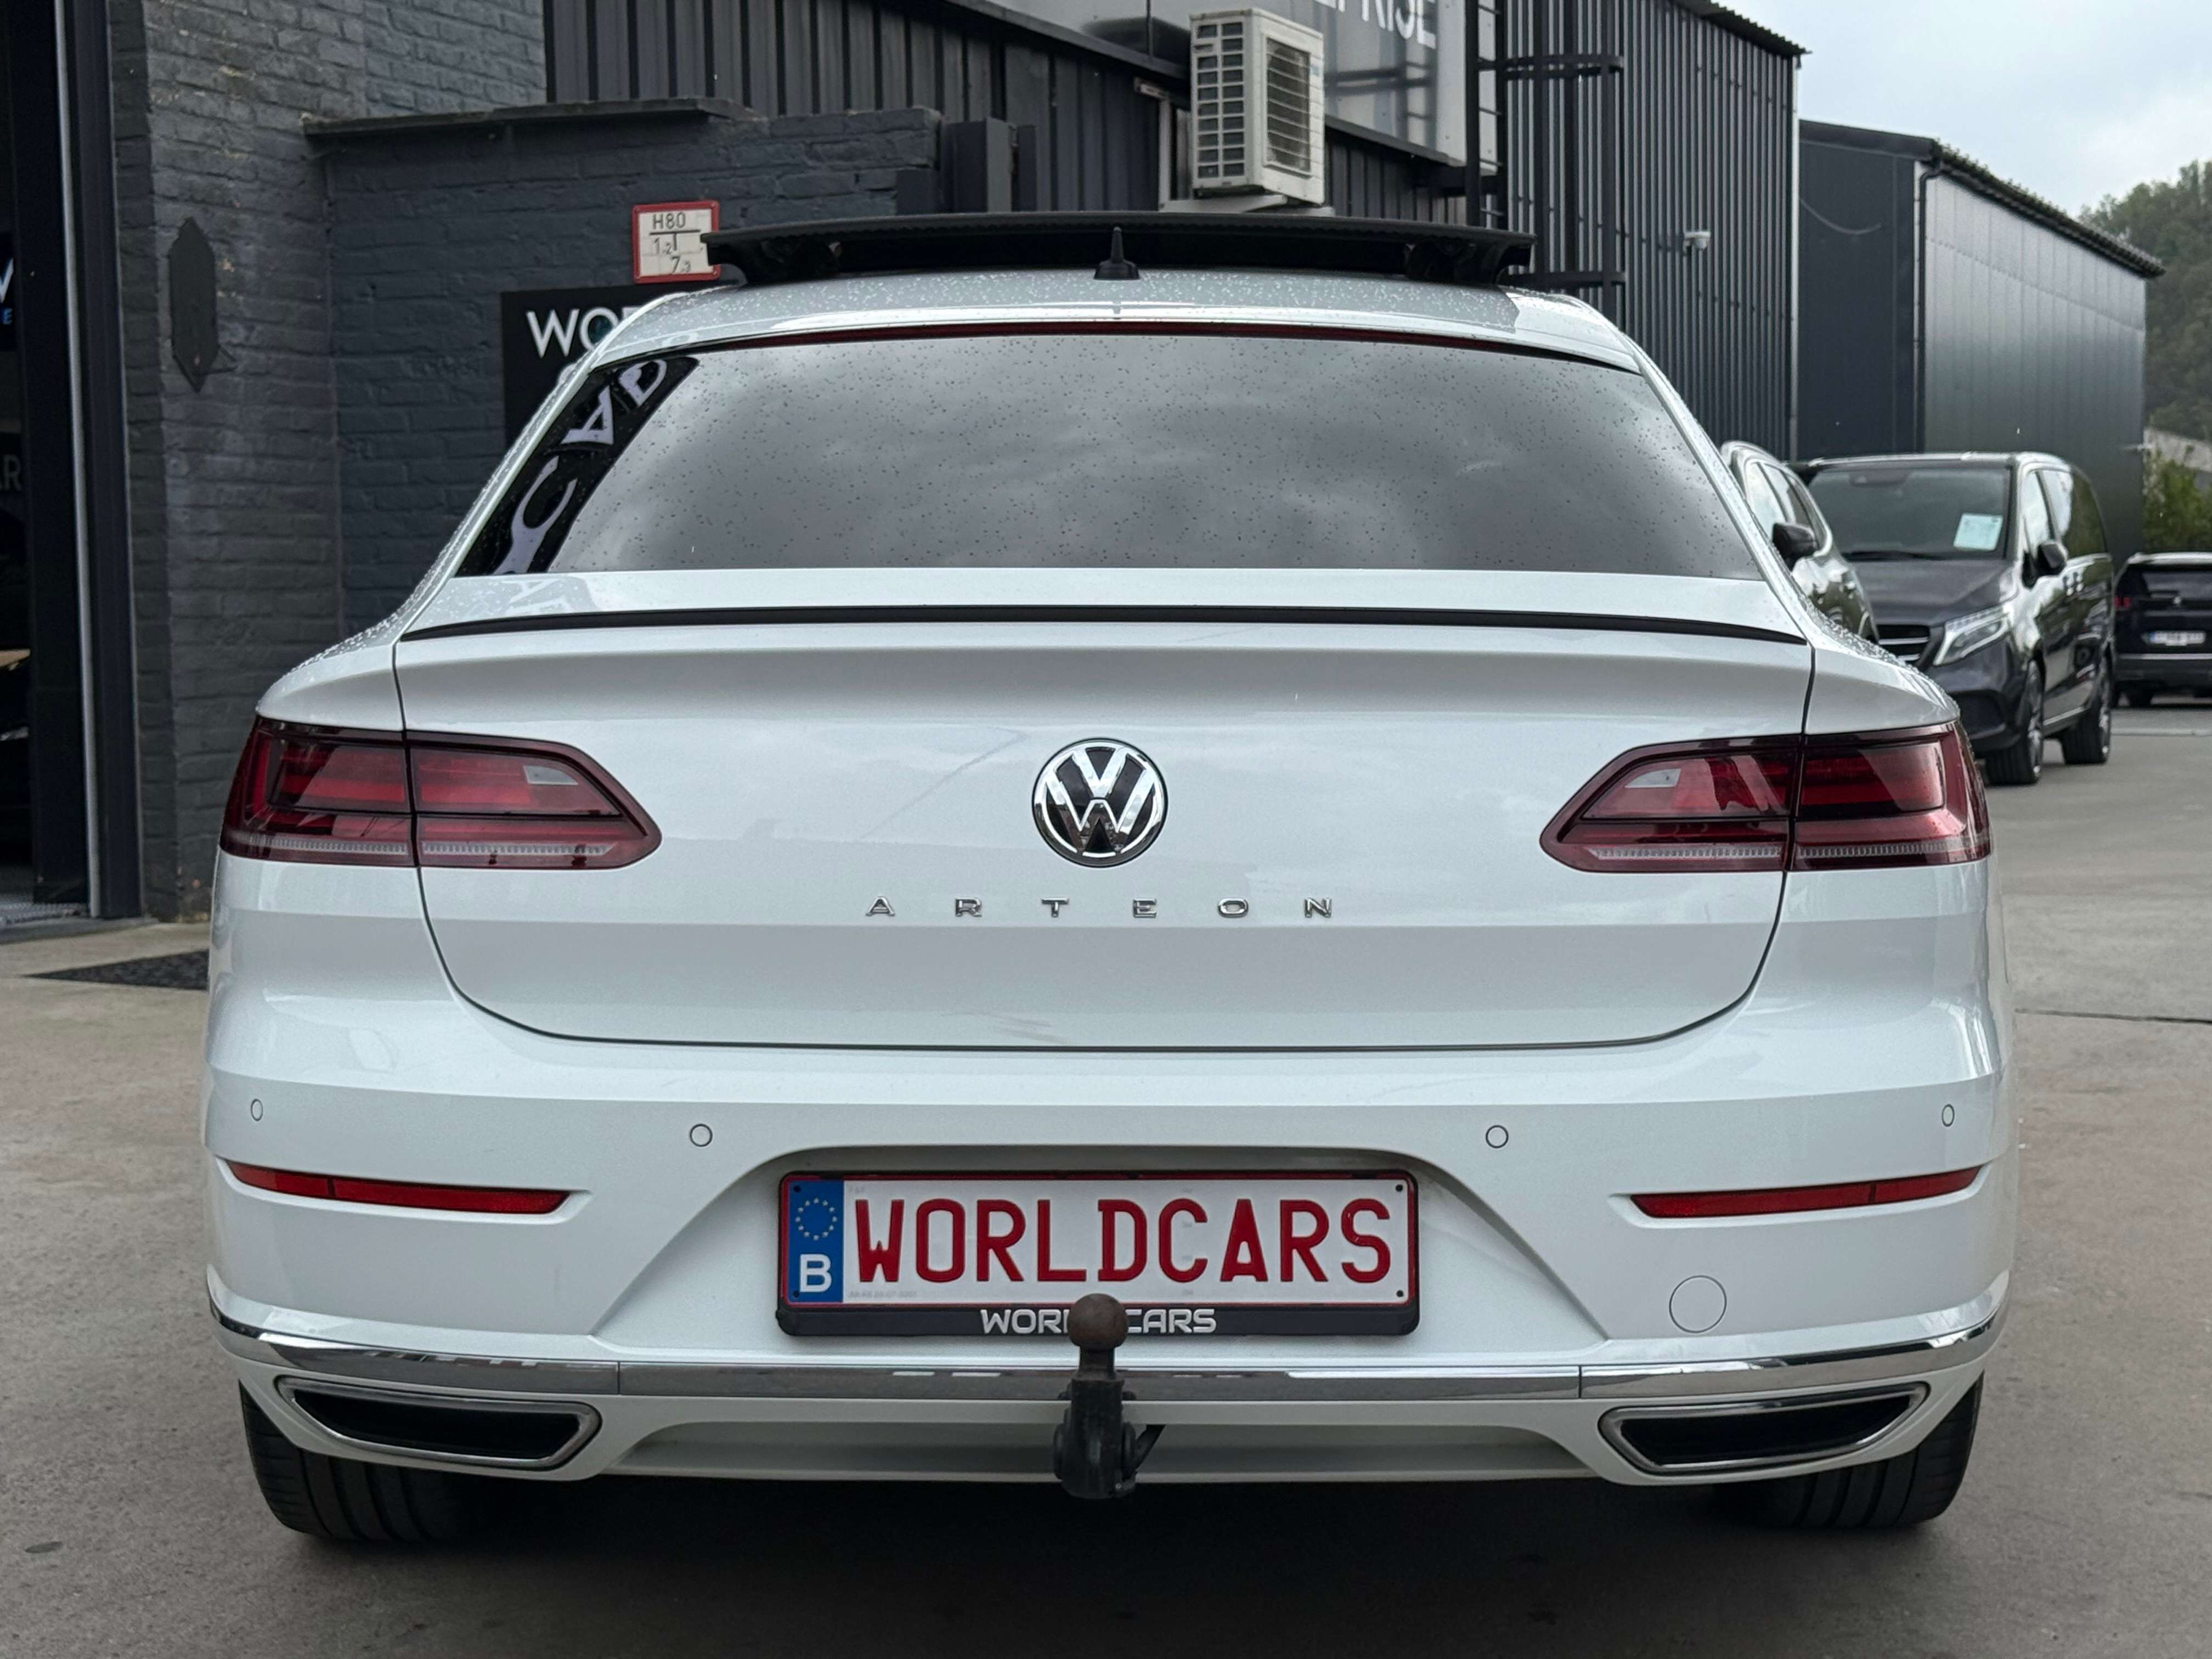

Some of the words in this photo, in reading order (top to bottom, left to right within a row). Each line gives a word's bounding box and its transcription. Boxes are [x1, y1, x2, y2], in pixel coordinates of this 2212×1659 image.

[652, 212, 686, 229] H80
[526, 307, 643, 358] WO
[865, 895, 1333, 918] ARTEON
[854, 1198, 1392, 1284] WORLDCARS
[799, 1254, 832, 1293] B
